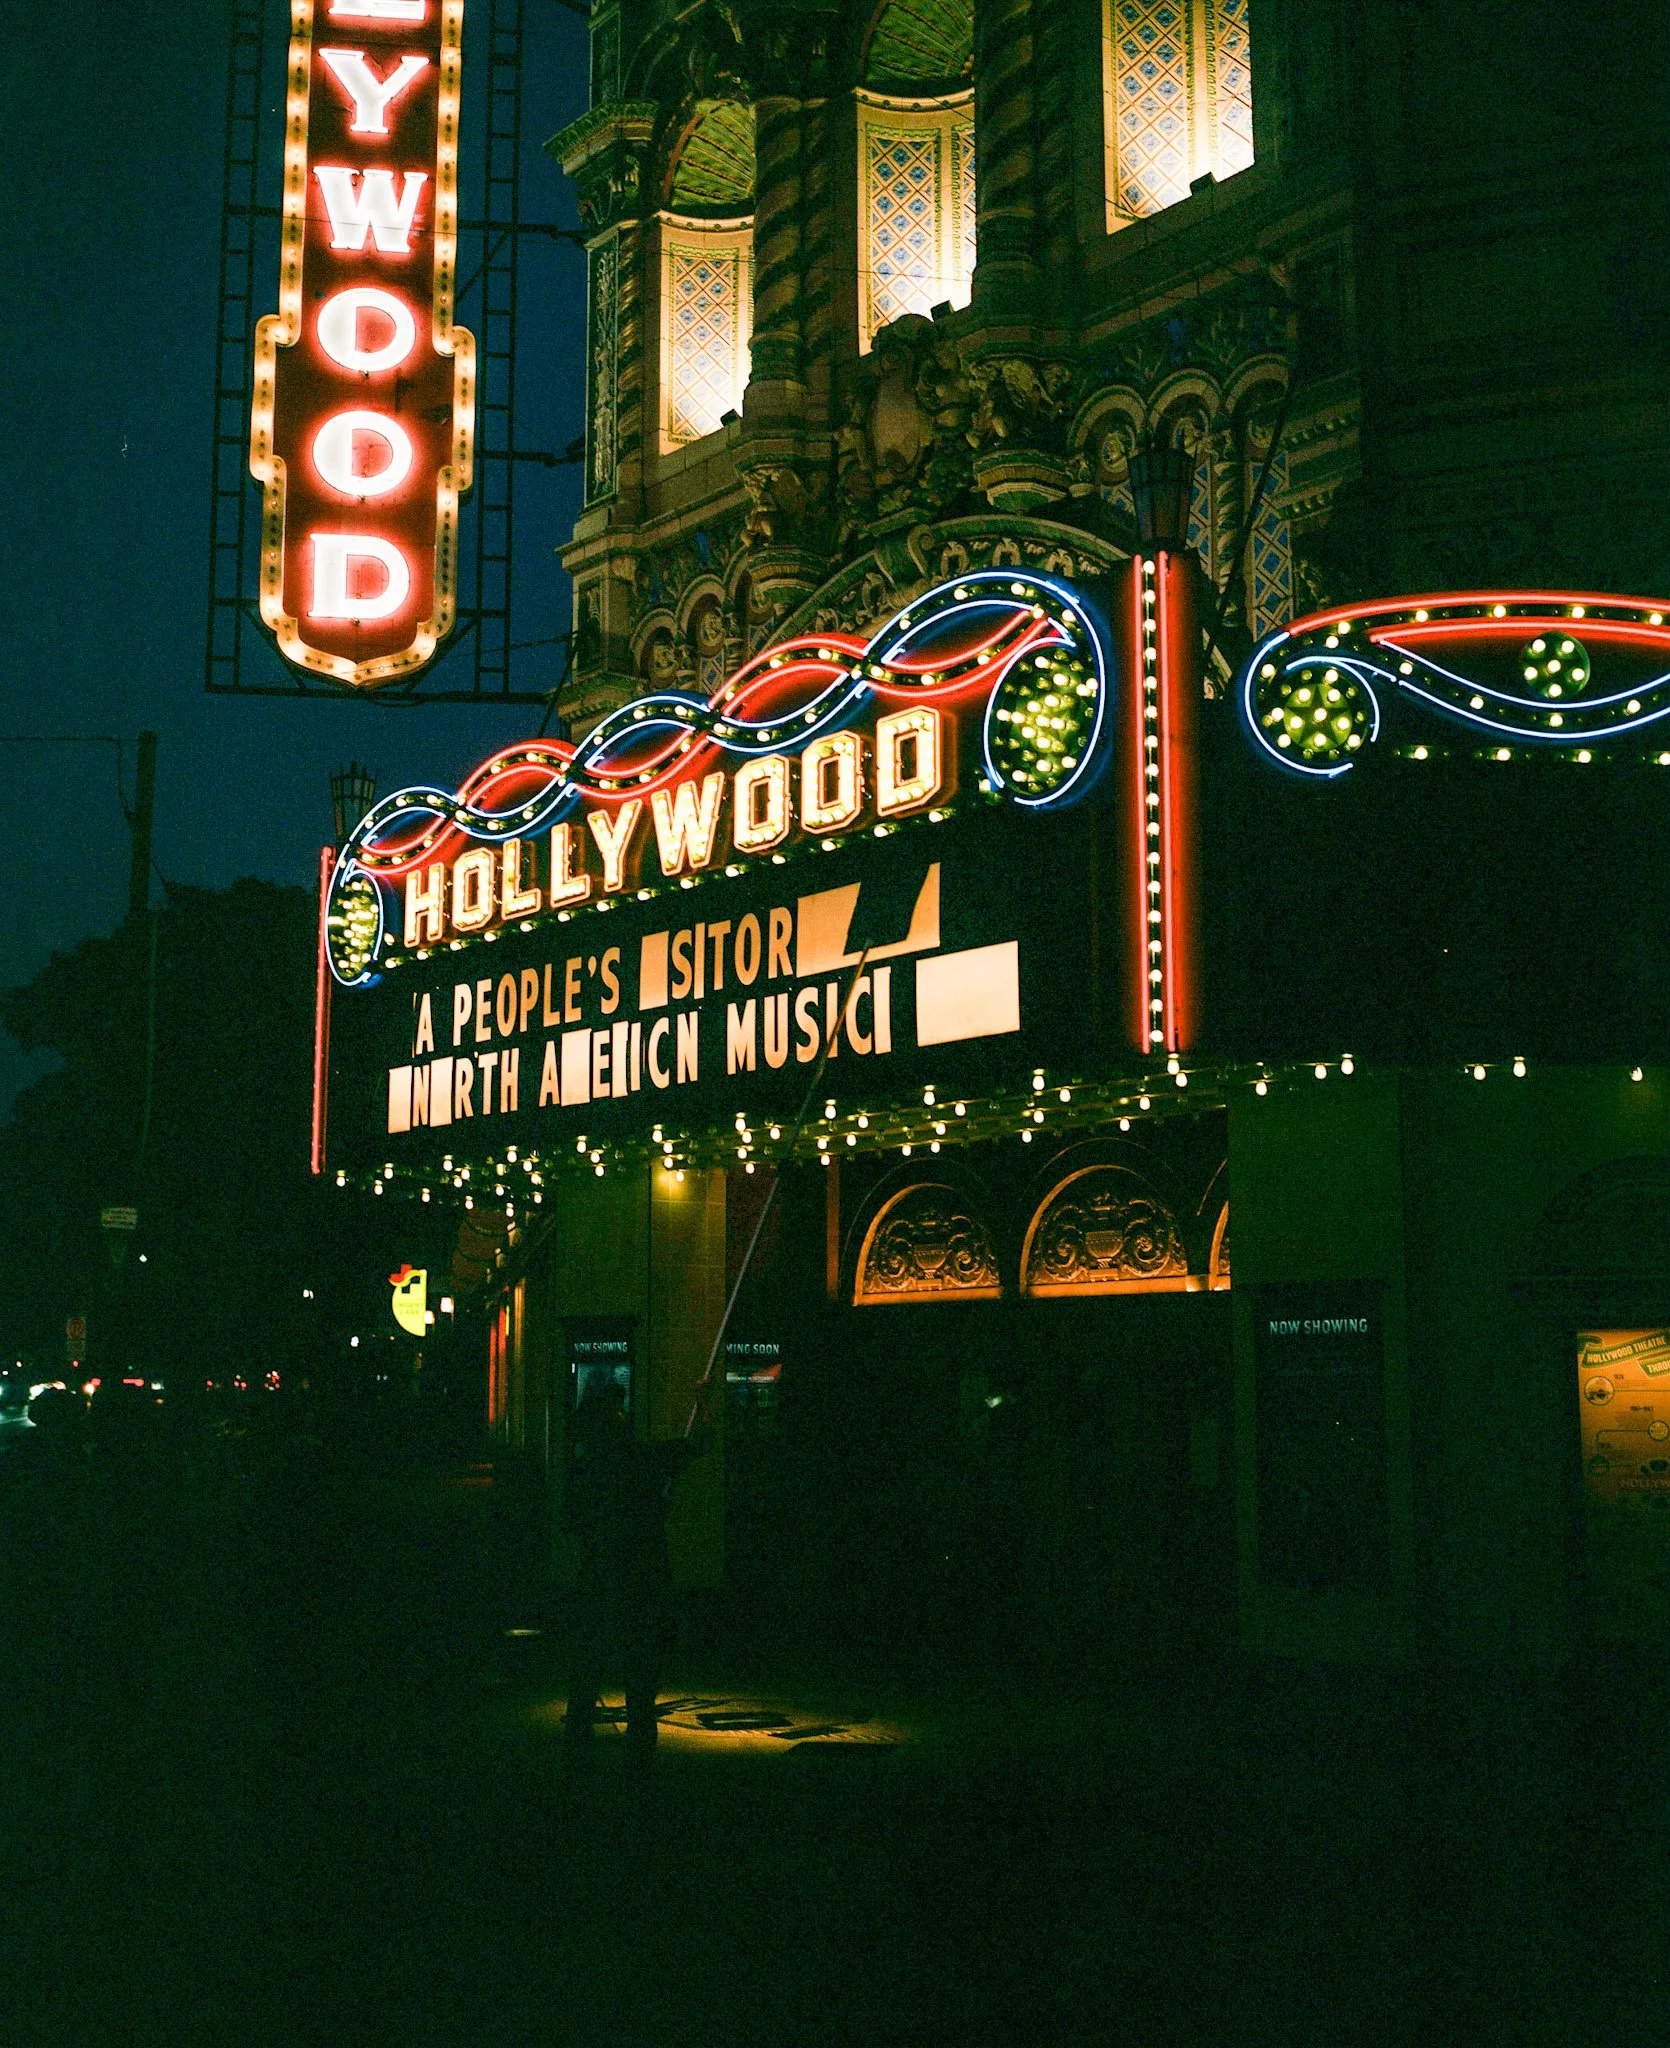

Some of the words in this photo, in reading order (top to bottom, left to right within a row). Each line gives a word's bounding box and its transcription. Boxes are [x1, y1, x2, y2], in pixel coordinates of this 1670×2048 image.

[306, 0, 429, 623] YWOOD
[404, 705, 941, 948] HOLLYWOOD
[415, 993, 434, 1055] A
[453, 946, 620, 1046] PEOPLE'S
[753, 1343, 780, 1354] SOON
[1269, 1321, 1300, 1335] NOW
[1304, 1318, 1368, 1334] SHOWING
[1587, 1345, 1634, 1363] HOLLYWOOD
[1633, 1336, 1666, 1353] THEATRE
